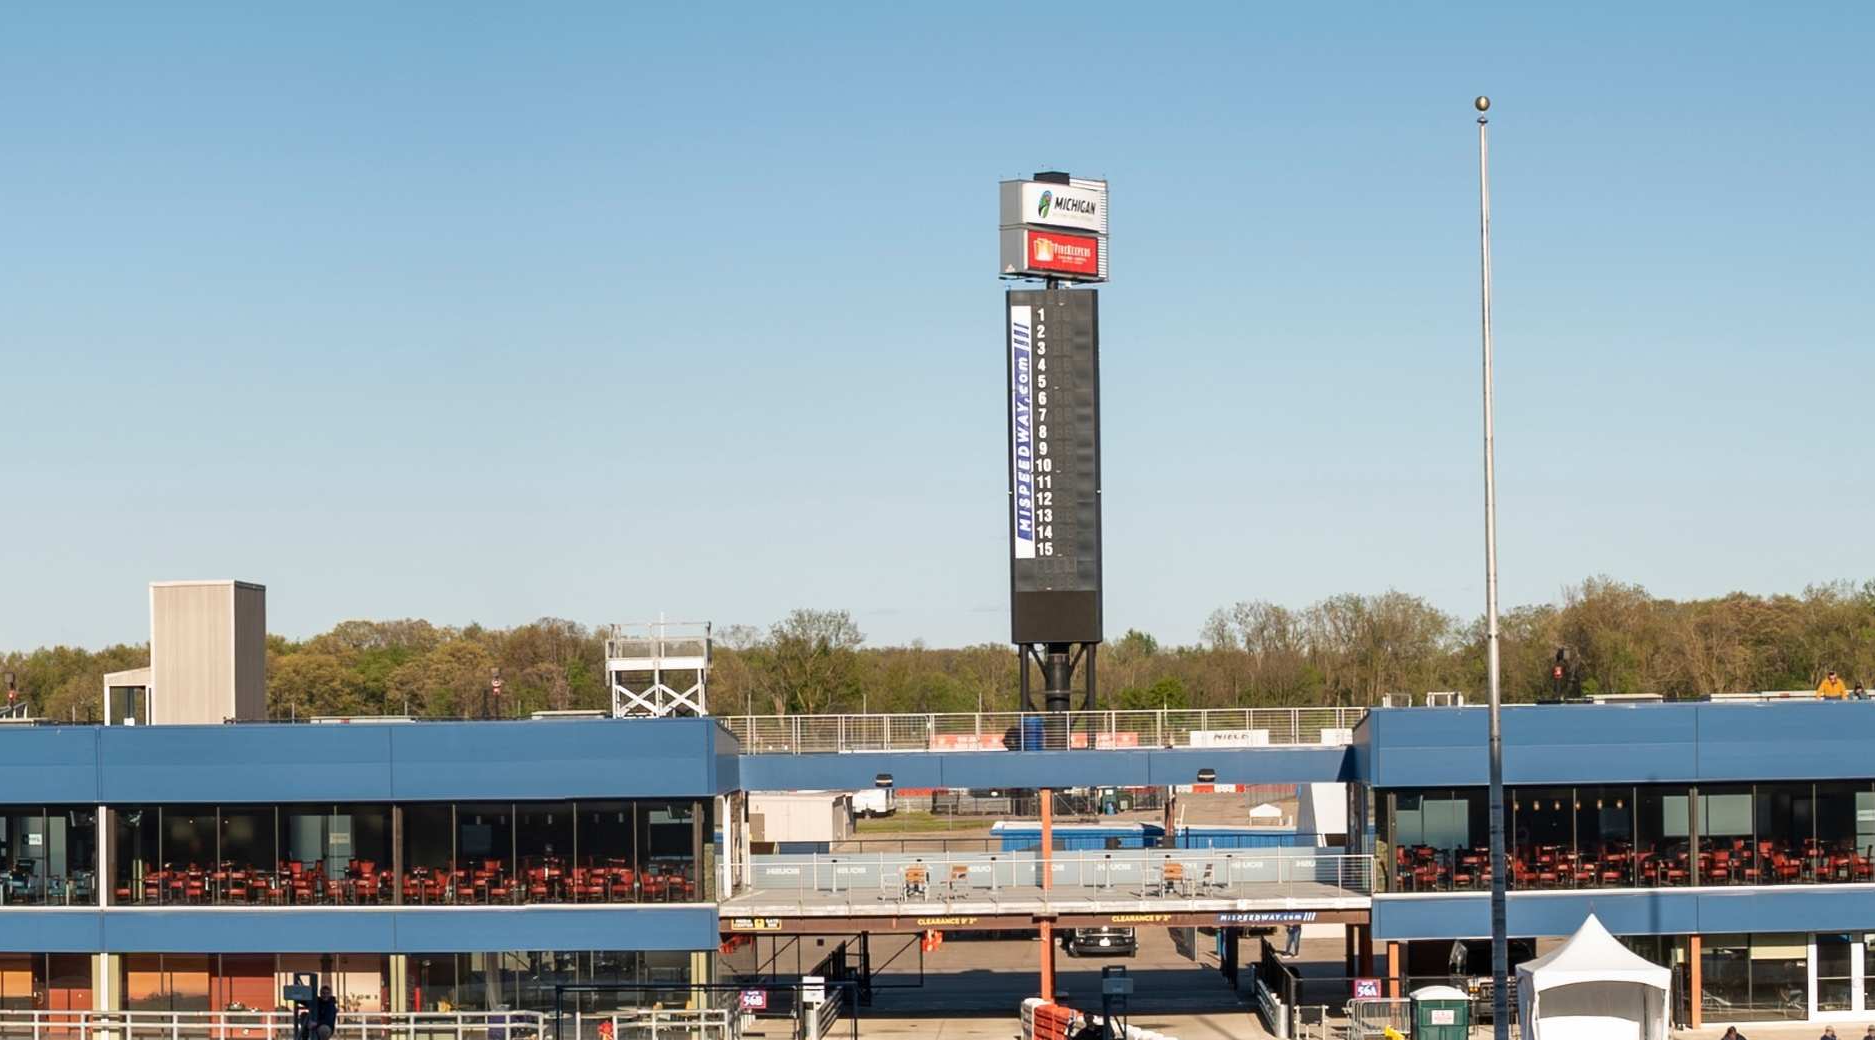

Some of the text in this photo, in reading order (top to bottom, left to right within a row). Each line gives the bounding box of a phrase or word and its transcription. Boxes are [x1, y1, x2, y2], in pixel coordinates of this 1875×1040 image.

[1054, 197, 1097, 215] MICHIGAN
[1037, 308, 1045, 321] 1
[1037, 325, 1045, 338] 2
[1037, 341, 1046, 355] 3
[1037, 358, 1046, 371] 4
[1038, 375, 1046, 388] 5
[1038, 391, 1047, 405] 6
[1038, 408, 1047, 422] 7
[1039, 425, 1047, 438] 8
[1017, 356, 1032, 532] MISPEEDWAY.com
[1039, 442, 1047, 455] 9
[1035, 458, 1052, 472] 10
[1036, 475, 1051, 488] 11
[1036, 491, 1052, 505] 12
[1036, 508, 1053, 522] 13
[1036, 525, 1053, 538] 14
[1036, 542, 1053, 555] 15
[917, 917, 960, 925] CLEARANCE
[1219, 913, 1302, 921] MISPEEDWAY.com
[743, 995, 764, 1006] 56B
[1357, 988, 1377, 1000] 56A
